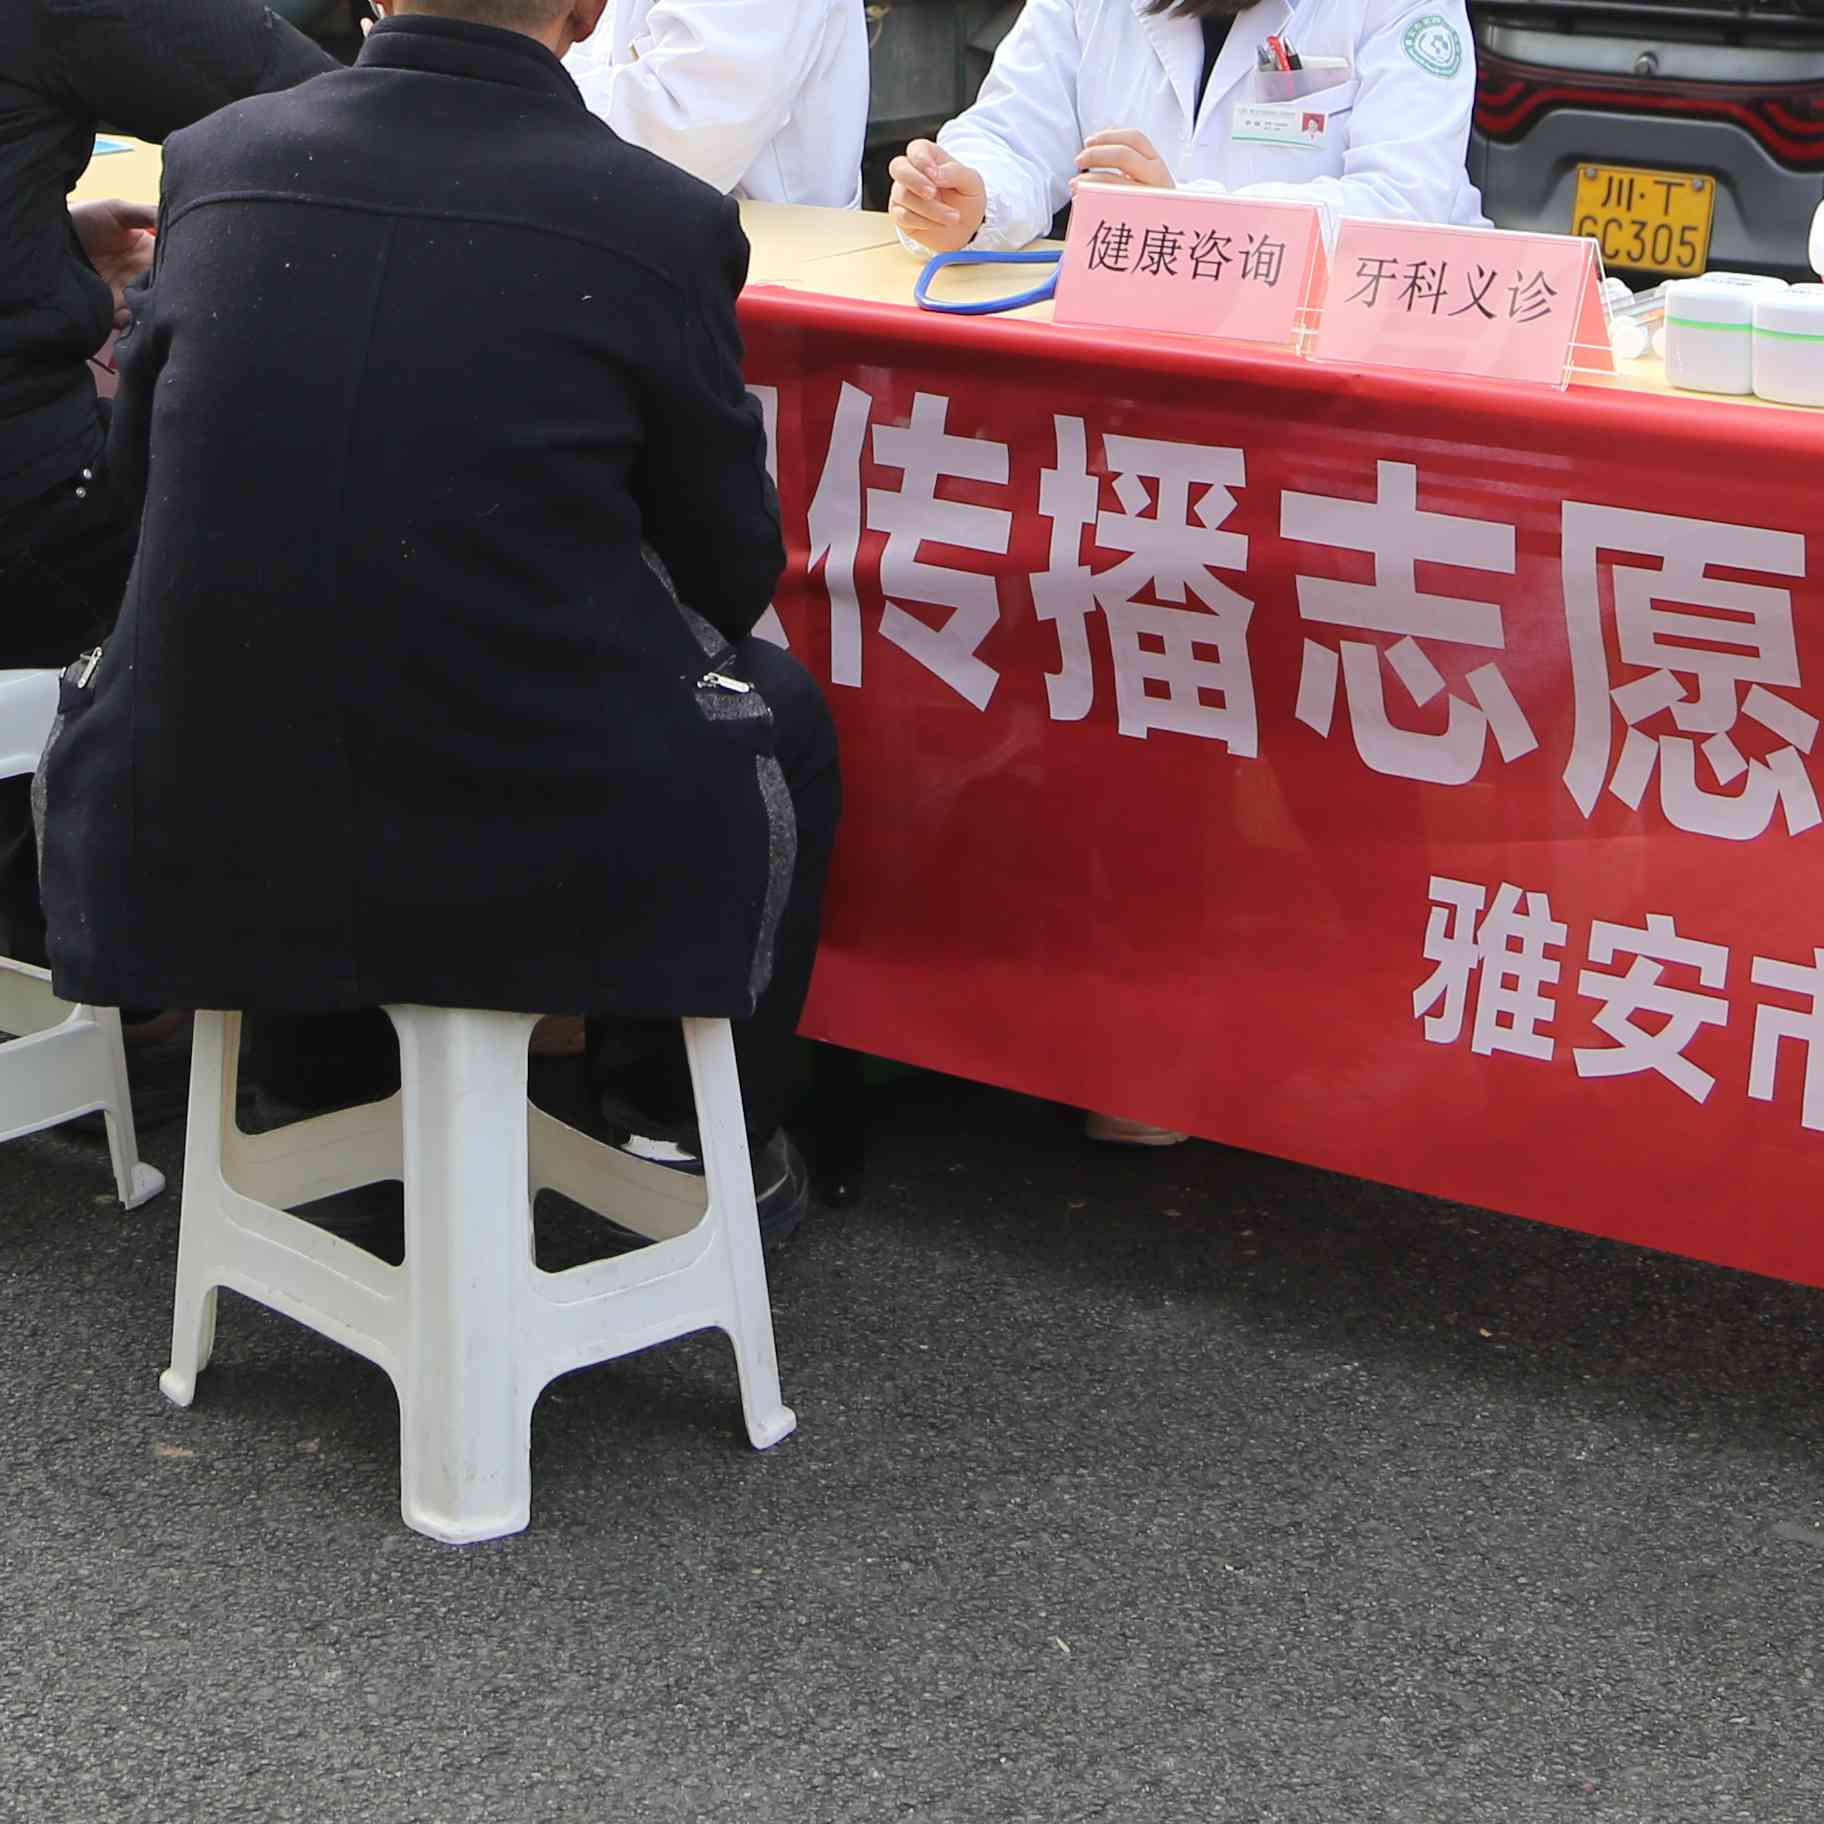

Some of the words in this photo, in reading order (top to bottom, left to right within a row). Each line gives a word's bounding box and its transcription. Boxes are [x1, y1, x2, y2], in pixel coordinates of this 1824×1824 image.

[1085, 219, 1287, 289] 健康咨询
[1343, 255, 1560, 324] 牙科义诊
